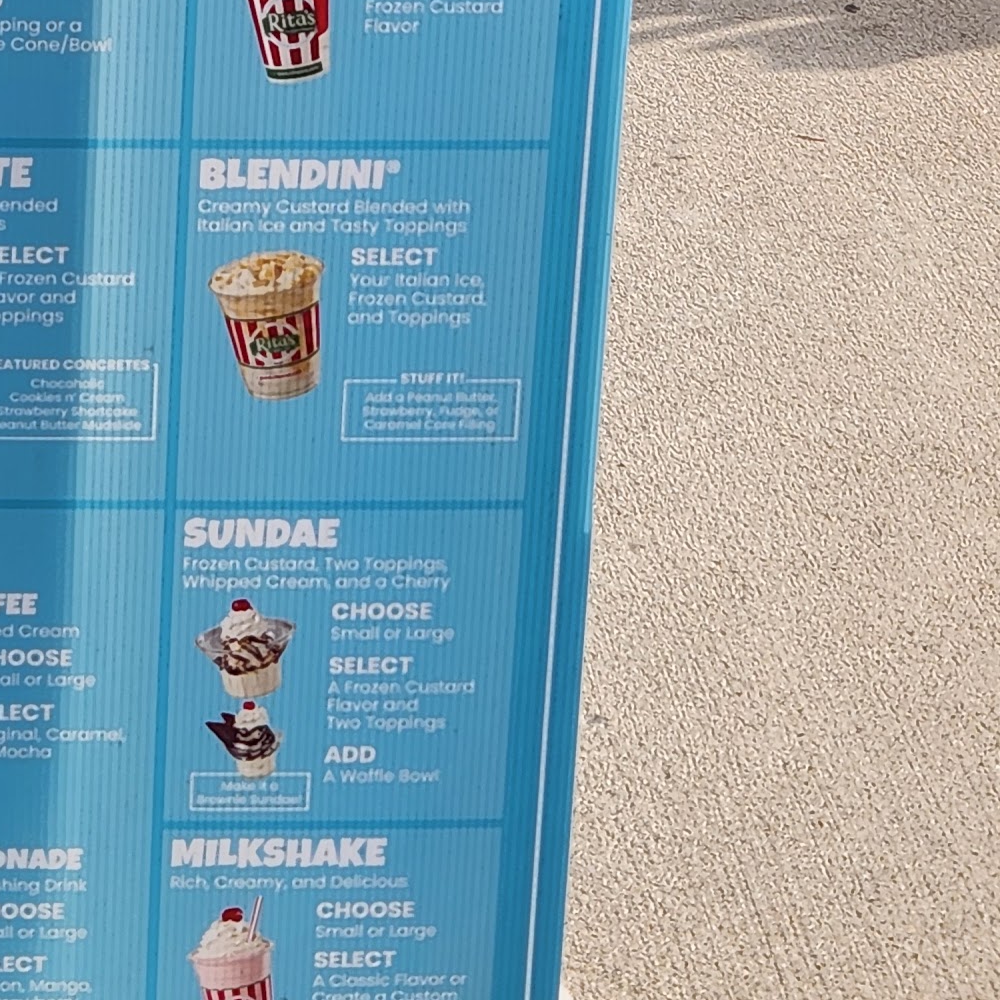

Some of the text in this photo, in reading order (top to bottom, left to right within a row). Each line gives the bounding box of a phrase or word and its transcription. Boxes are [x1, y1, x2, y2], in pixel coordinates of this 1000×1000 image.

[46, 20, 64, 32] or
[70, 20, 82, 32] a
[269, 11, 315, 33] Rita's
[63, 359, 150, 371] CONCRETES
[401, 373, 442, 383] STUFF
[184, 518, 340, 548] SUNDAE
[332, 603, 433, 620] CHOOSE
[19, 625, 79, 638] Cream
[329, 657, 414, 673] SELECT
[171, 837, 388, 869] MILKSHAKE
[45, 879, 87, 892] Drink
[292, 875, 326, 889] and
[331, 875, 408, 889] Delicious
[317, 902, 414, 919] CHOOSE
